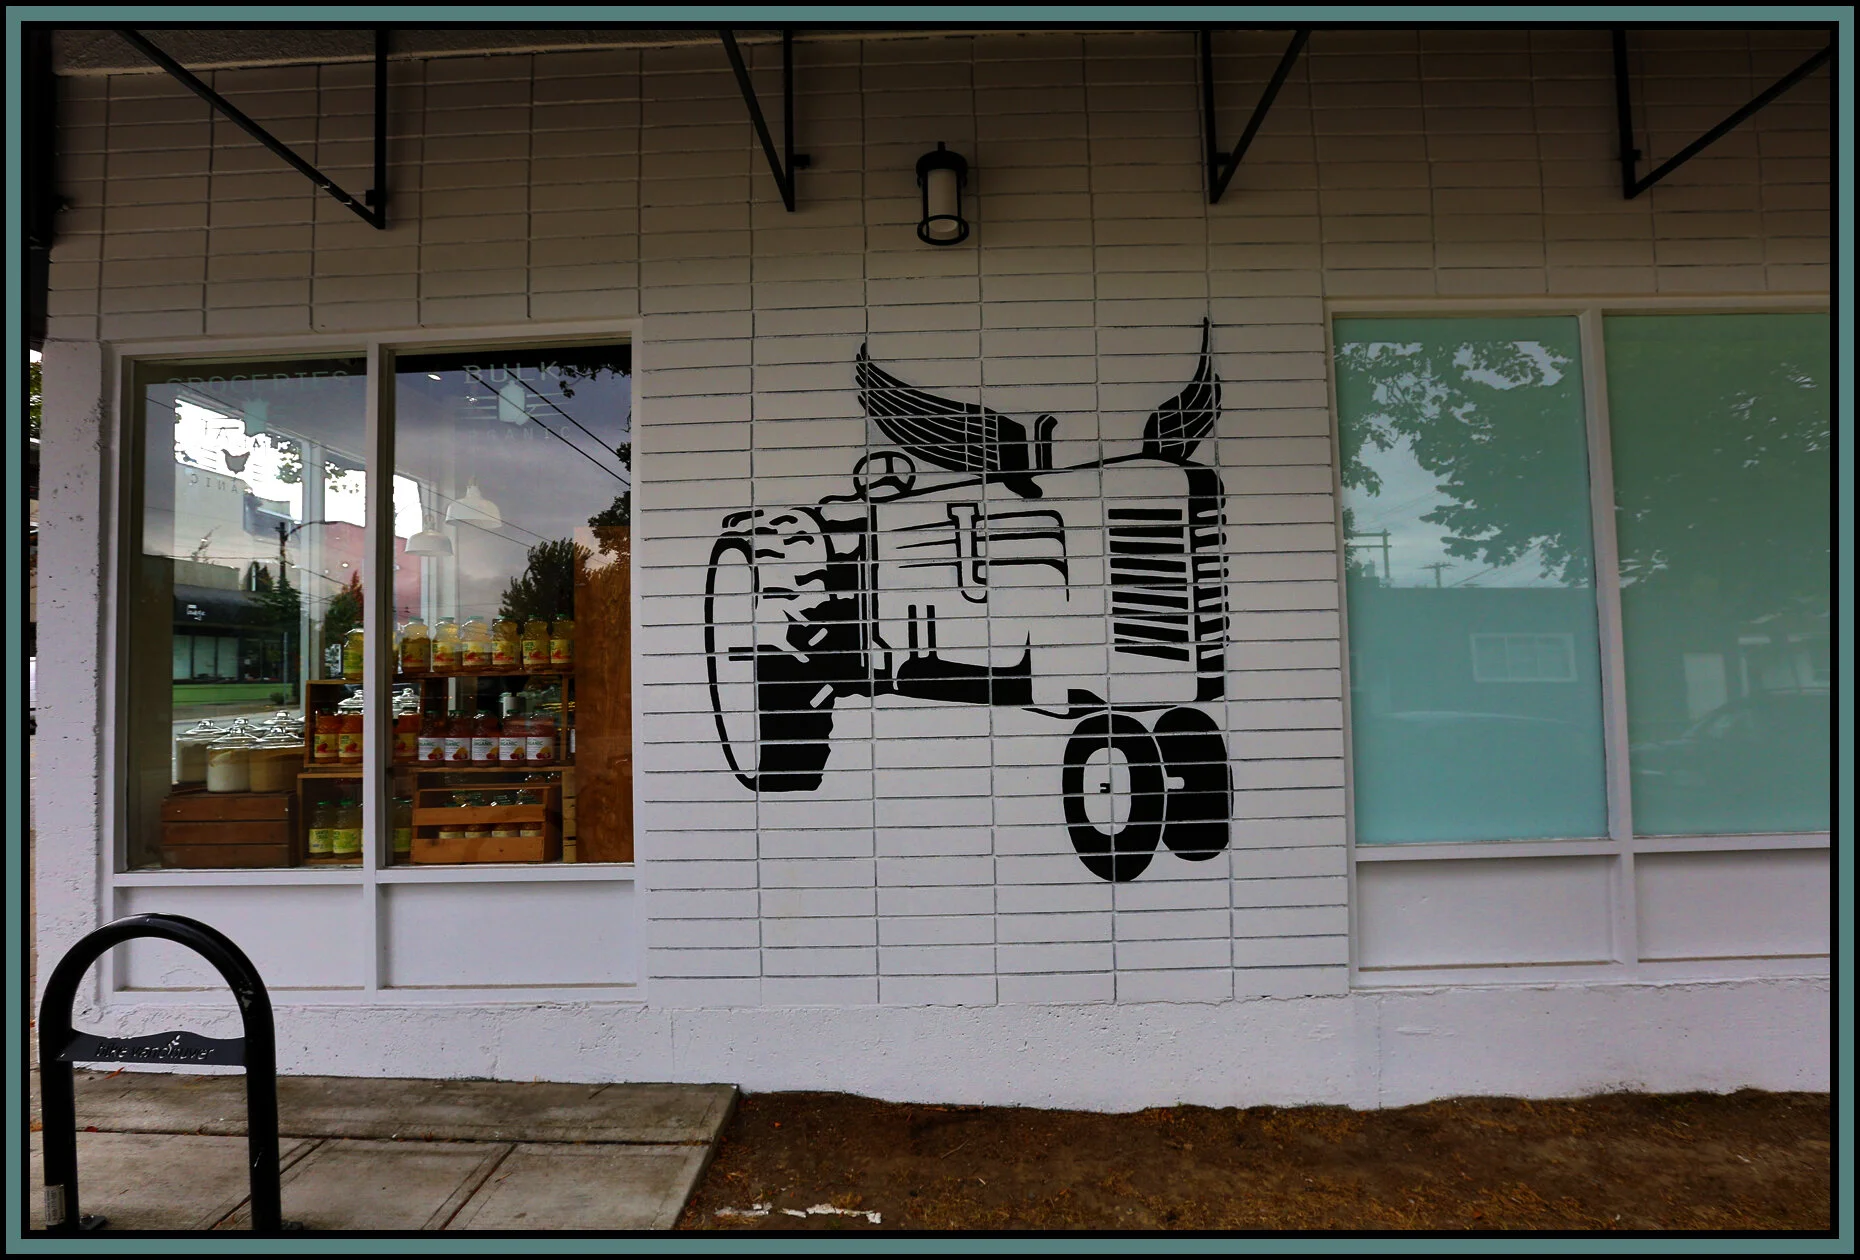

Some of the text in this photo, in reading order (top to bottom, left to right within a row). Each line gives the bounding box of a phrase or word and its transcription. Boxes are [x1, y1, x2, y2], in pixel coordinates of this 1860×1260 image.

[461, 360, 560, 384] BULK
[455, 425, 570, 442] RGANIC
[95, 1042, 128, 1059] bike
